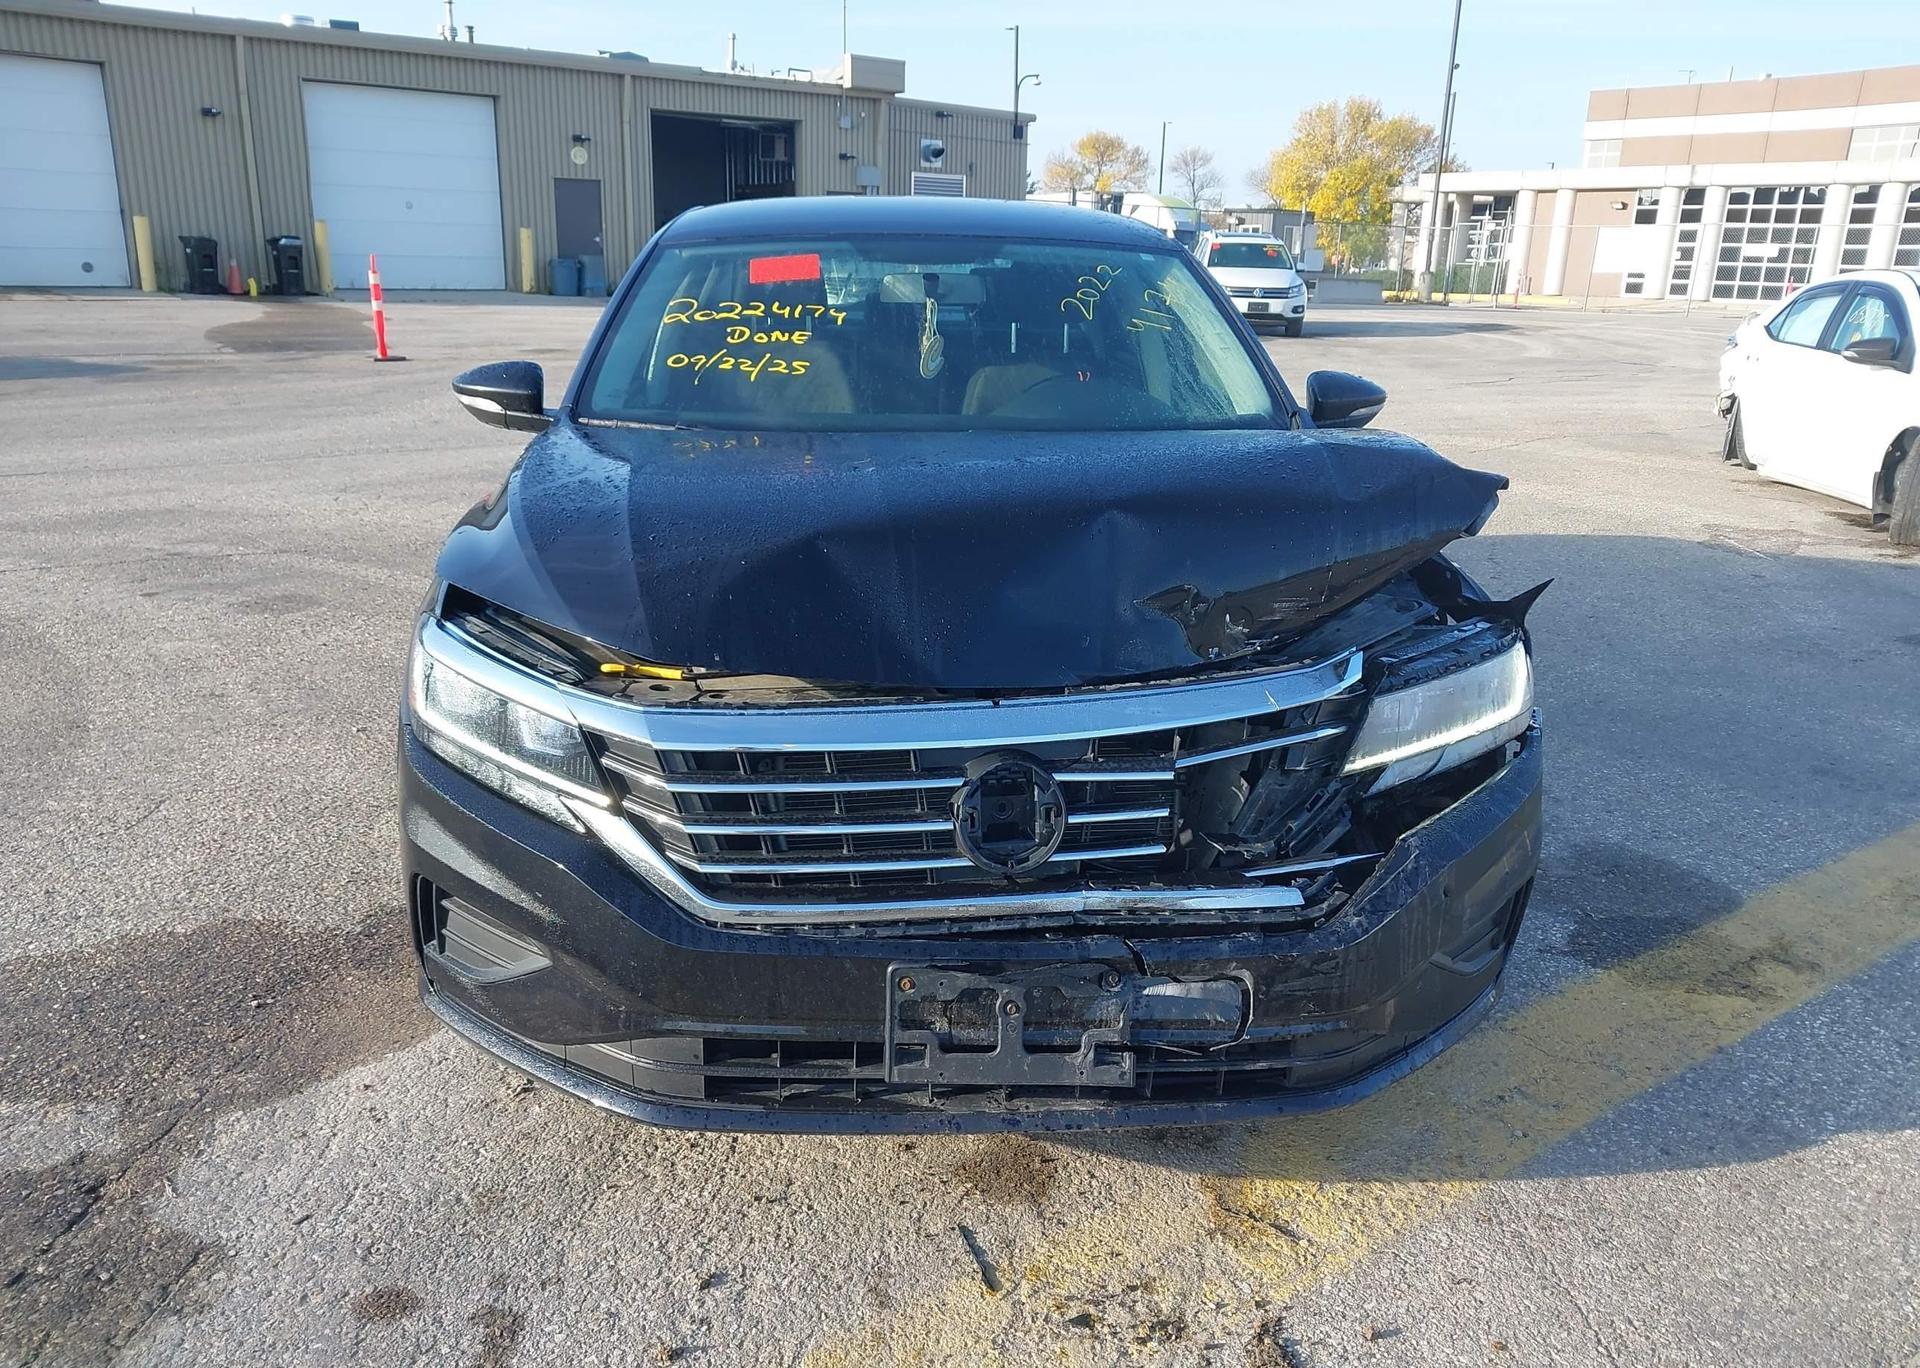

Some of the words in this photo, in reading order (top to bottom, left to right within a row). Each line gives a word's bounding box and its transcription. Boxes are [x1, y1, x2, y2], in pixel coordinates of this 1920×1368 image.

[1061, 264, 1123, 320] 2022
[663, 298, 848, 326] 20224174
[725, 326, 812, 344] DONE
[666, 348, 811, 384] 09/22/25
